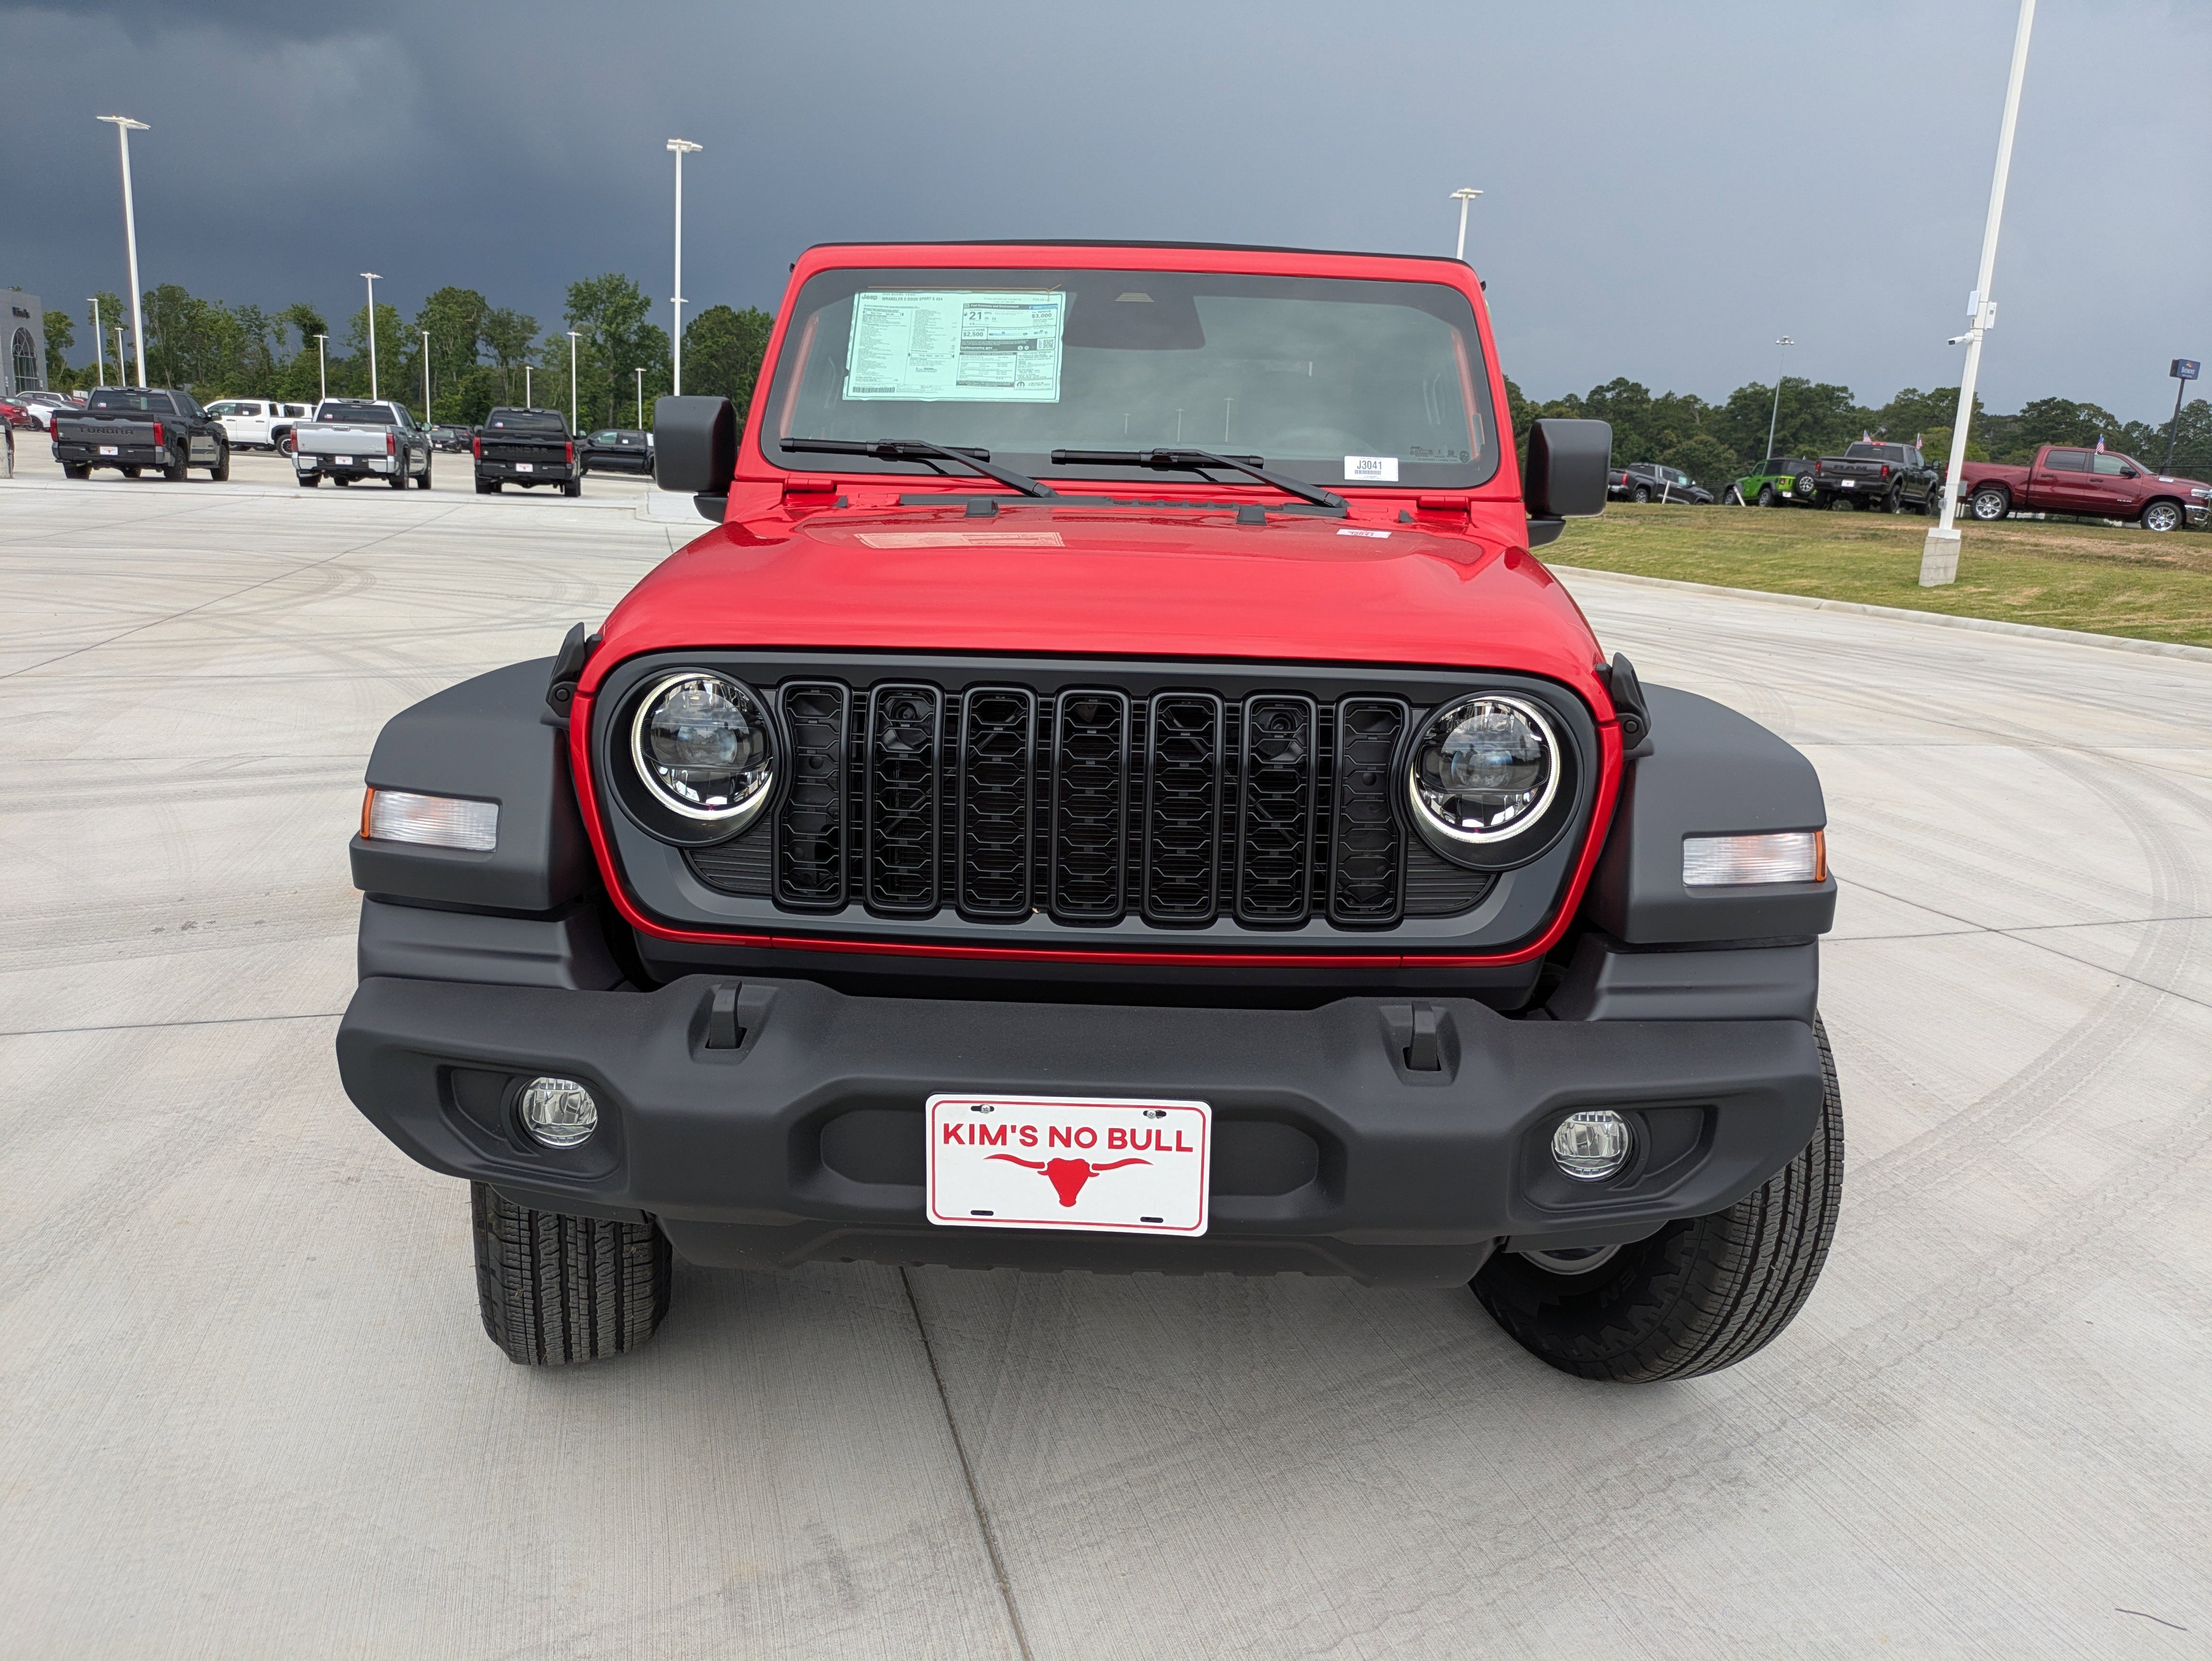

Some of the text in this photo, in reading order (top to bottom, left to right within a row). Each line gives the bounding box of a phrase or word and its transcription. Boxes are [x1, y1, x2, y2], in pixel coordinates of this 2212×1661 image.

[969, 311, 982, 320] 21
[1357, 460, 1382, 470] J3041
[943, 1123, 1194, 1153] KIM'S NO BULL
